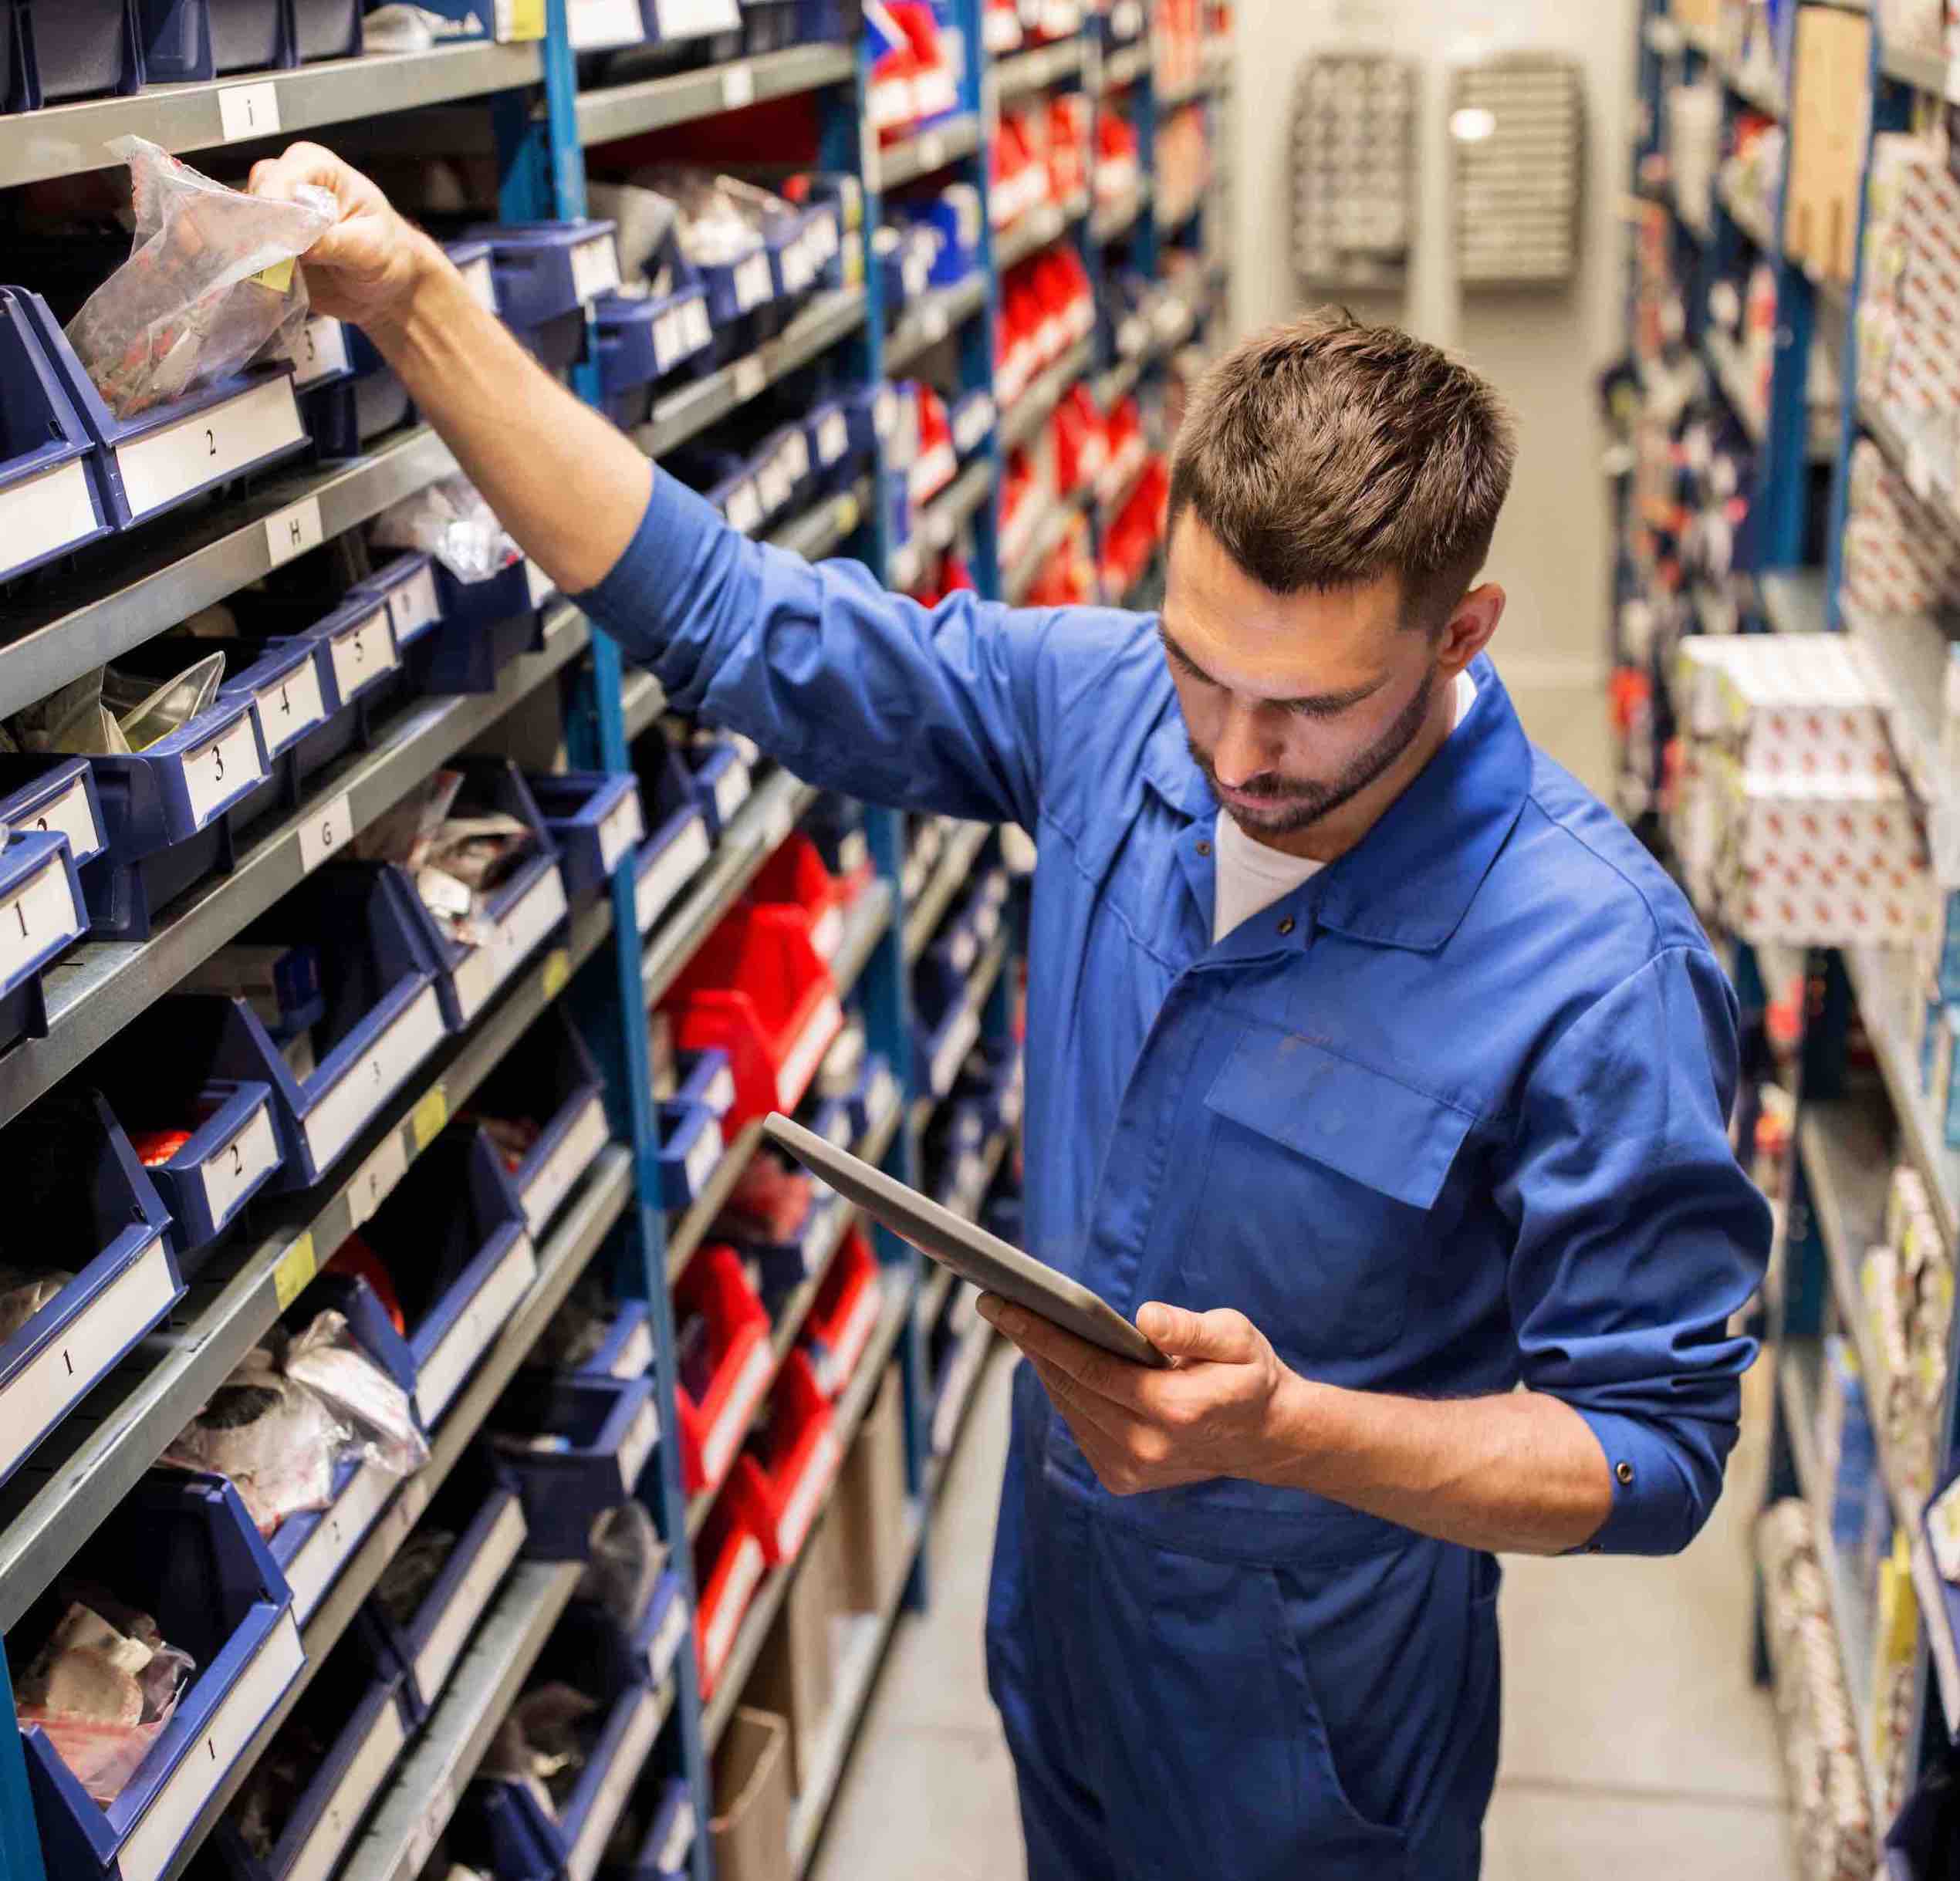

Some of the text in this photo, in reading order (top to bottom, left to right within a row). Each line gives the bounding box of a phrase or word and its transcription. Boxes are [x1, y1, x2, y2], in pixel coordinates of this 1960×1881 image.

[247, 98, 254, 127] i
[204, 425, 217, 456] 2
[289, 518, 302, 545] H
[281, 684, 290, 715] 4
[211, 745, 224, 782] 3
[322, 821, 333, 847] G
[15, 900, 29, 937] 1
[230, 1143, 243, 1177] 2
[63, 1349, 73, 1377] 1
[208, 1737, 215, 1761] 1
